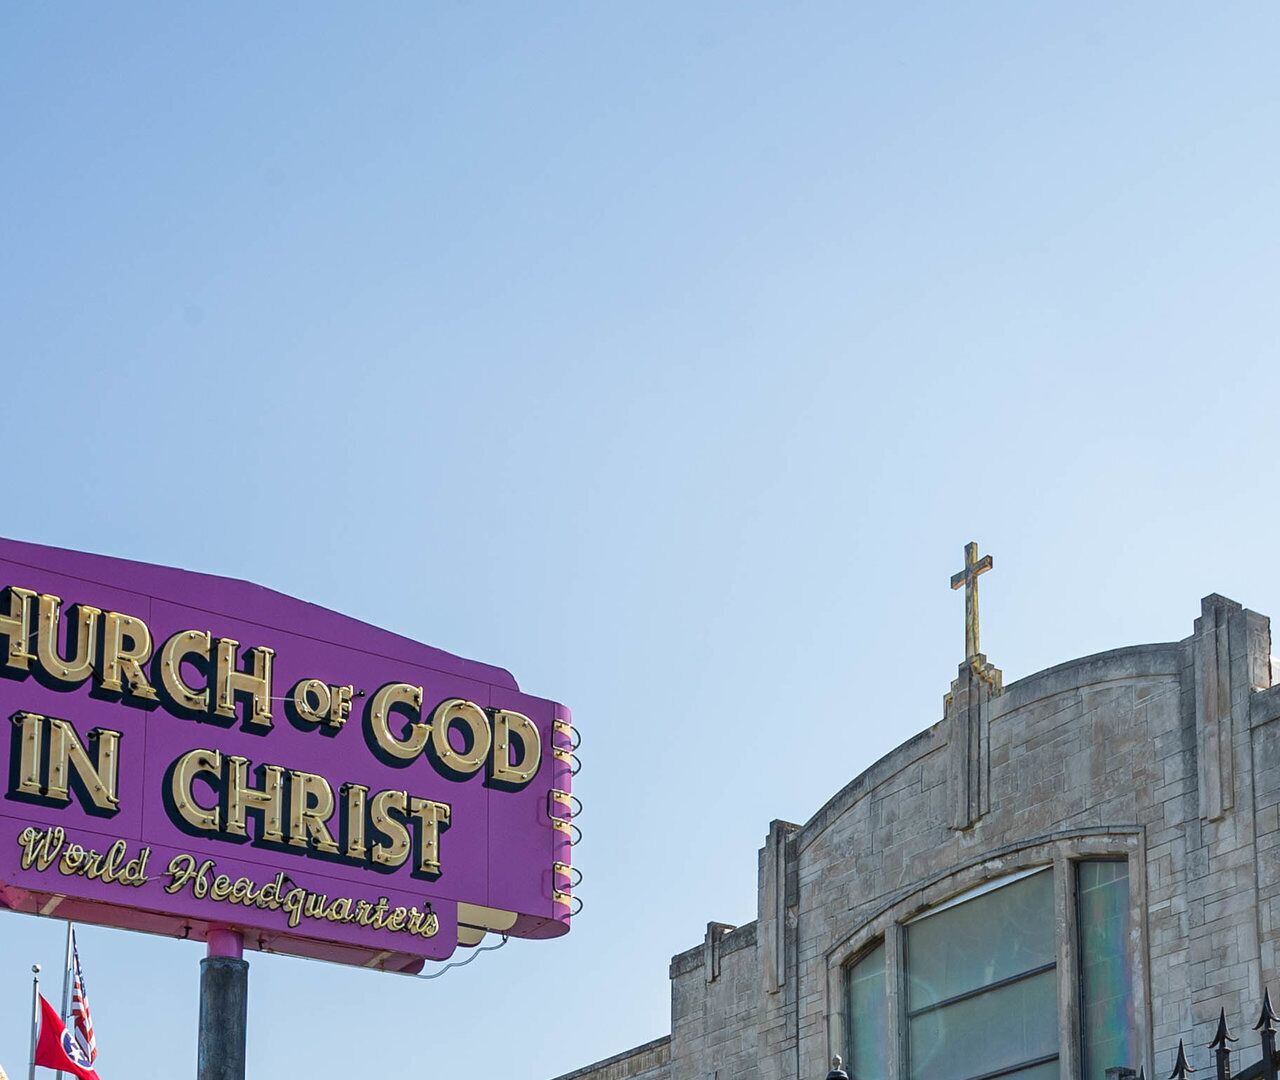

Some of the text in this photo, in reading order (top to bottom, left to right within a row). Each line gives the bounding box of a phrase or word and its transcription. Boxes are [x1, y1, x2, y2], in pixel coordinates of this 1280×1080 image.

[293, 679, 354, 728] OF
[370, 682, 542, 784] GOD
[14, 712, 452, 874] IN CHRIST
[17, 826, 440, 937] World Headquarters
